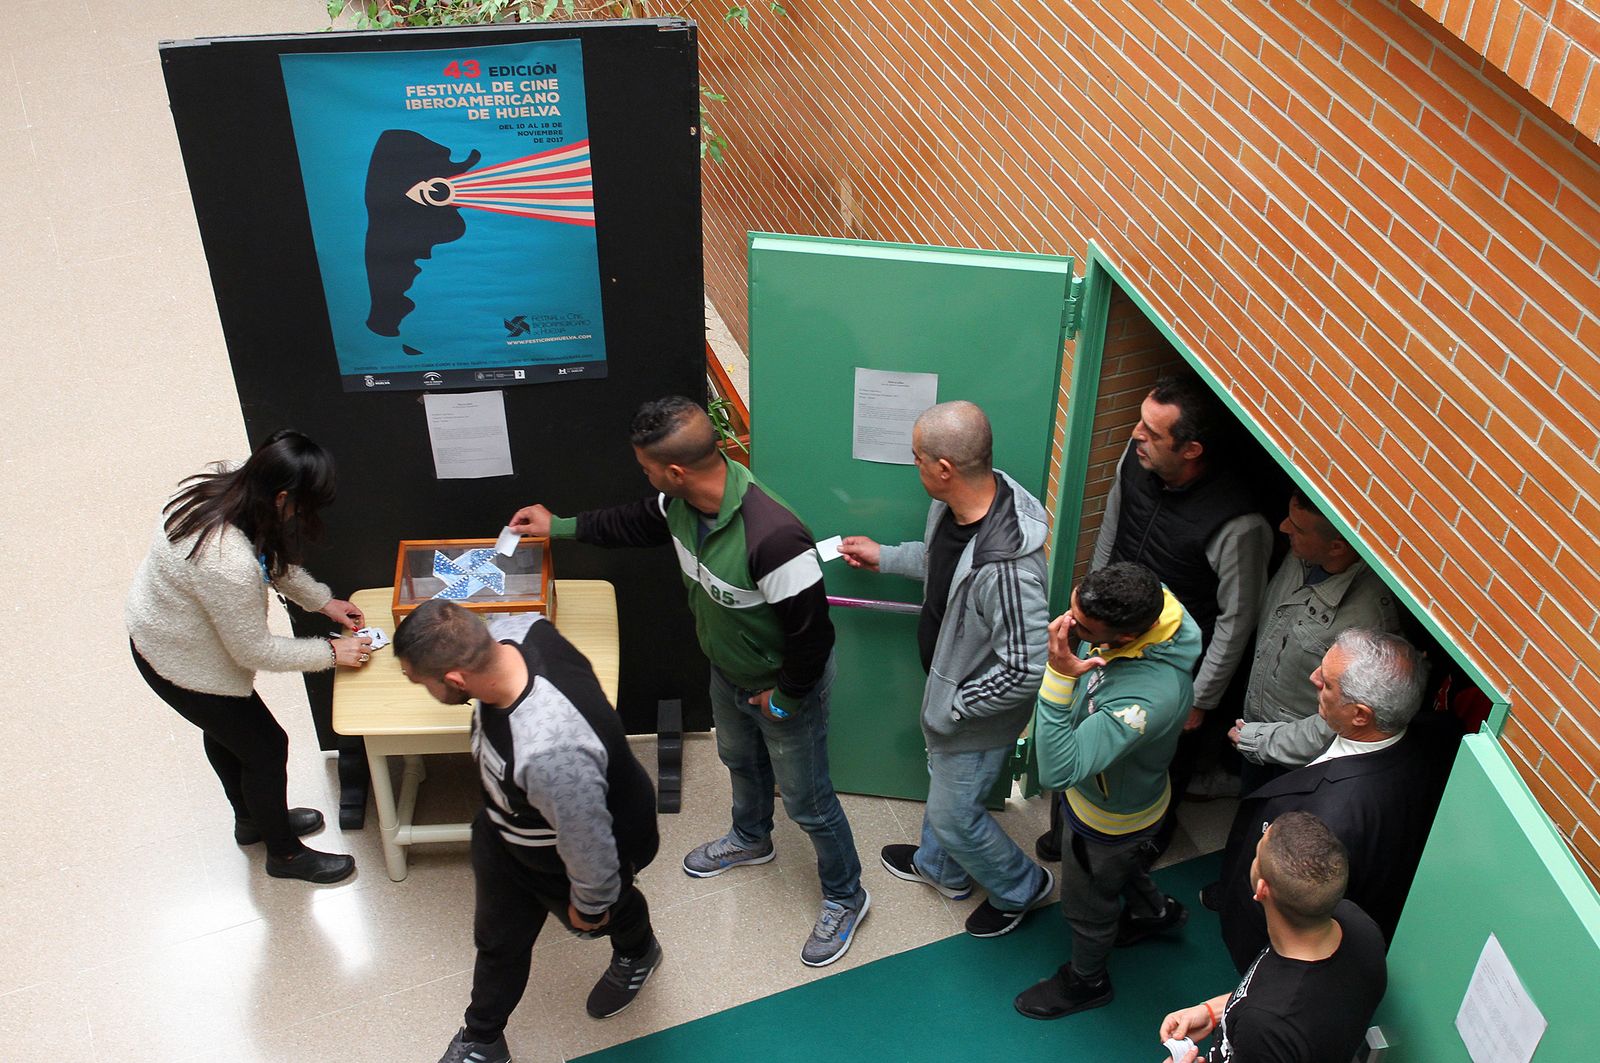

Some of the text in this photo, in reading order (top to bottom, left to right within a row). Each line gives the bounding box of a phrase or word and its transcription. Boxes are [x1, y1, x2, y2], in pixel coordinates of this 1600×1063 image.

[443, 59, 557, 79] 43 EDICIÓN
[405, 78, 559, 97] FESTIVAL DE CINE
[405, 92, 560, 110] IBEROAMERICANO
[467, 105, 561, 121] DE HUELVA
[517, 129, 564, 137] NOVIEMBRE
